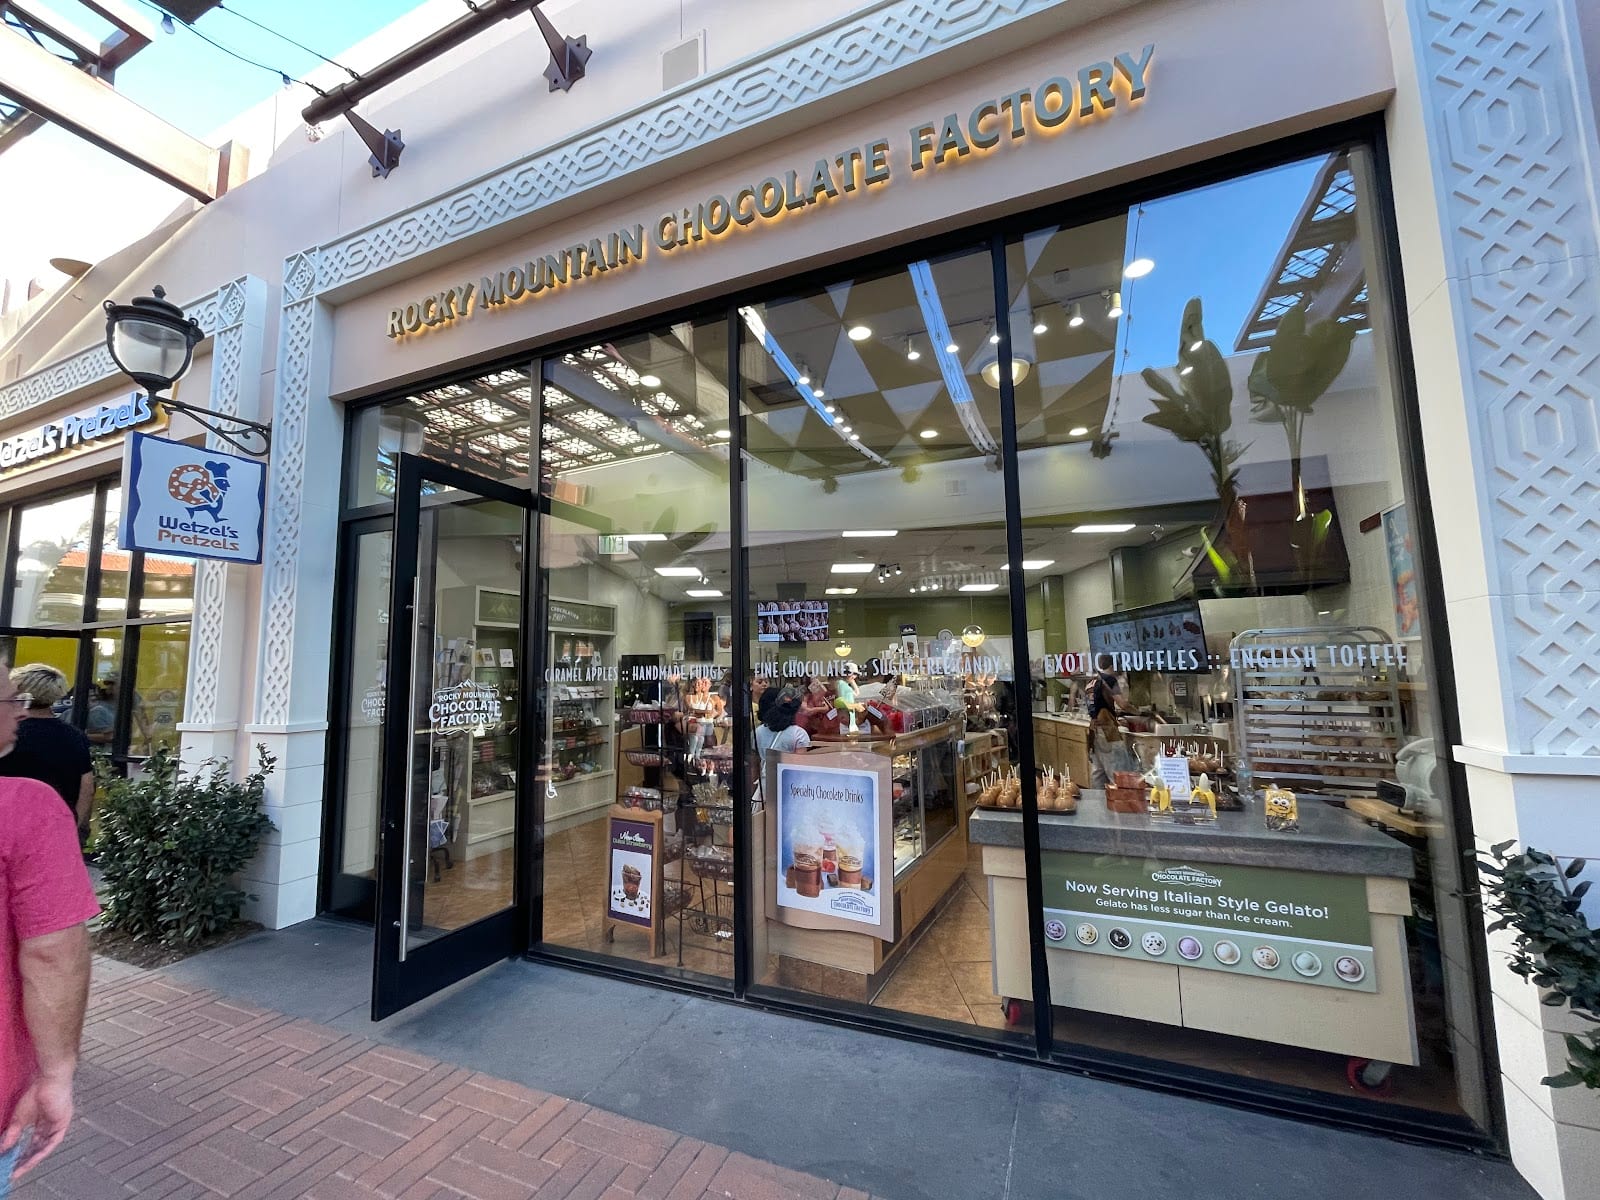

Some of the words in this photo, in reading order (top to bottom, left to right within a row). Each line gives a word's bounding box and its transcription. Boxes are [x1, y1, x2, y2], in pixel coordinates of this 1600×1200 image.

[385, 283, 474, 338] ROCKY
[479, 224, 644, 309] MOUNTAIN
[653, 138, 890, 250] CHOCOLATE
[909, 43, 1155, 171] FACTORY
[0, 424, 58, 468] etzel's
[60, 392, 151, 448] Pretzels
[158, 515, 239, 539] Wetzel's
[157, 529, 240, 551] Pretzels
[754, 661, 779, 678] FINE
[872, 658, 914, 676] SUGAR
[957, 655, 1000, 674] CANDY
[1044, 652, 1104, 673] EXOTIC
[1109, 649, 1199, 672] TRUFFLES
[1230, 646, 1316, 669] ENGLISH
[1326, 643, 1408, 667] TOFFEE
[545, 667, 583, 682] CARAMEL
[585, 666, 618, 682] APPLES
[632, 664, 688, 681] HANDMADE
[438, 692, 461, 702] ROCKY
[463, 690, 495, 699] MOUNTAIN
[429, 700, 502, 723] CHOCOLATE
[440, 712, 495, 728] FACTORY
[790, 783, 815, 801] Specialty
[815, 785, 844, 801] Chocolate
[844, 788, 864, 804] Drinks
[1151, 873, 1190, 881] CHOCOLATE
[1192, 876, 1222, 887] FACTORY
[1066, 880, 1097, 894] Now
[1102, 884, 1158, 902] Serving
[1164, 890, 1212, 906] Italian
[1217, 895, 1259, 911] Style
[1265, 901, 1329, 919] Gelato!
[1096, 898, 1128, 909] Gelato
[1131, 902, 1148, 911] has
[1151, 904, 1170, 913] less
[1173, 907, 1202, 917] sugar
[1206, 910, 1231, 920] than
[1233, 913, 1250, 923] Ice
[1253, 917, 1293, 928] cream.
